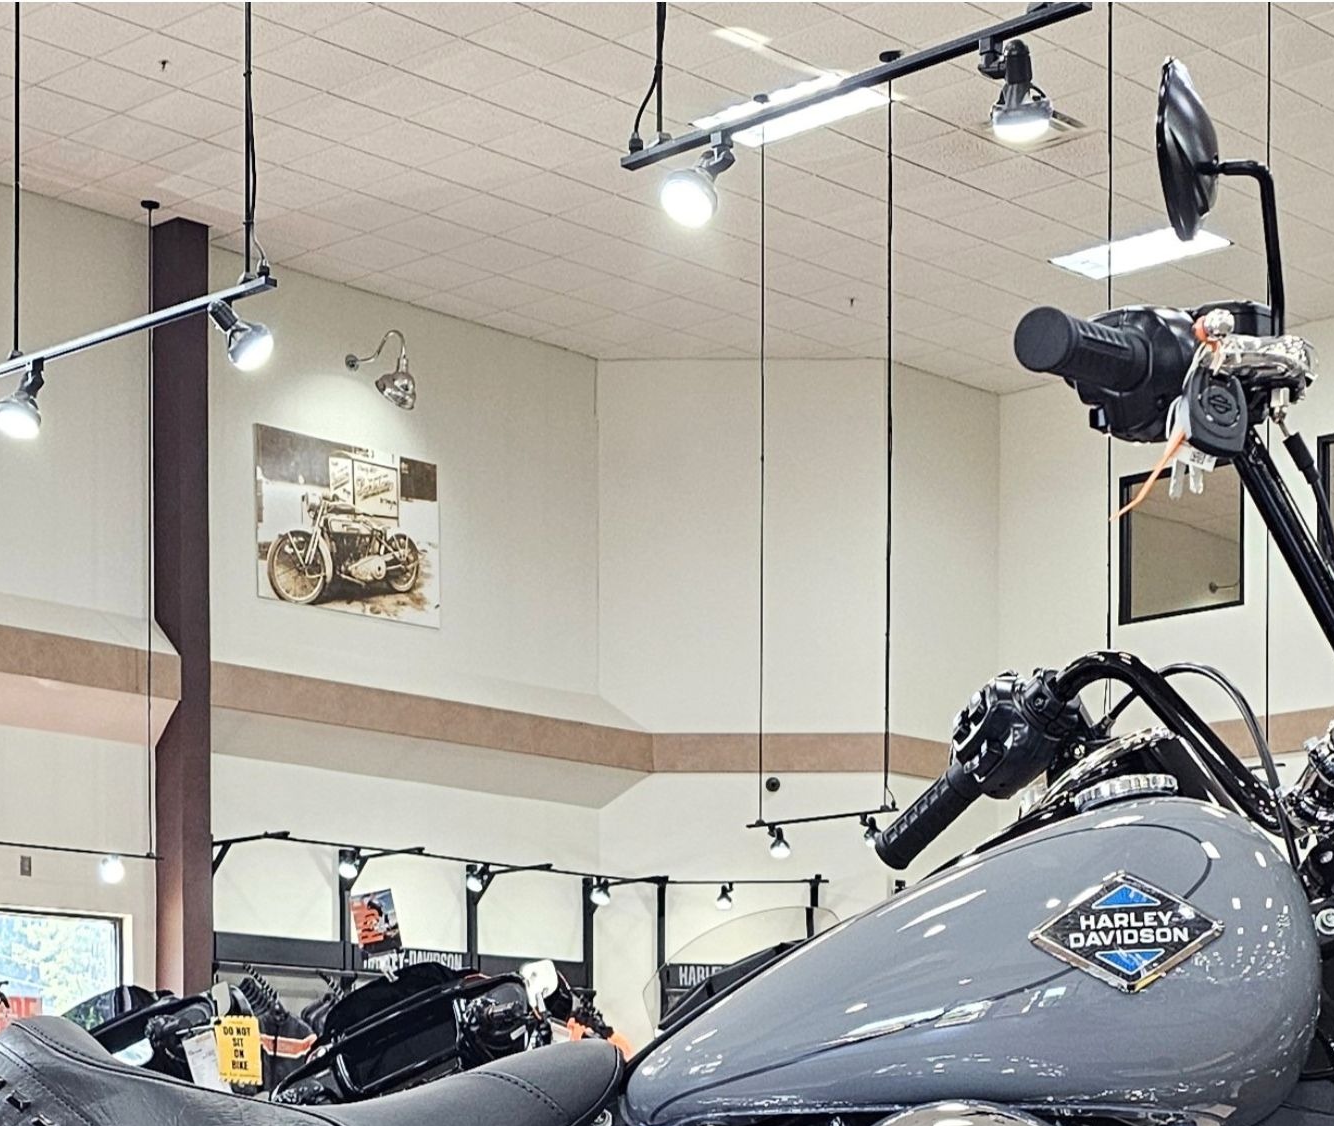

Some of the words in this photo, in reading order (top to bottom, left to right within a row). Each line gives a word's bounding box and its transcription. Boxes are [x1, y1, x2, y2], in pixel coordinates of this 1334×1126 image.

[1068, 927, 1190, 949] DAVIDSON
[223, 1027, 234, 1036] DO
[236, 1026, 250, 1036] NOT
[232, 1037, 243, 1047] SIT
[232, 1061, 248, 1070] BIKE
